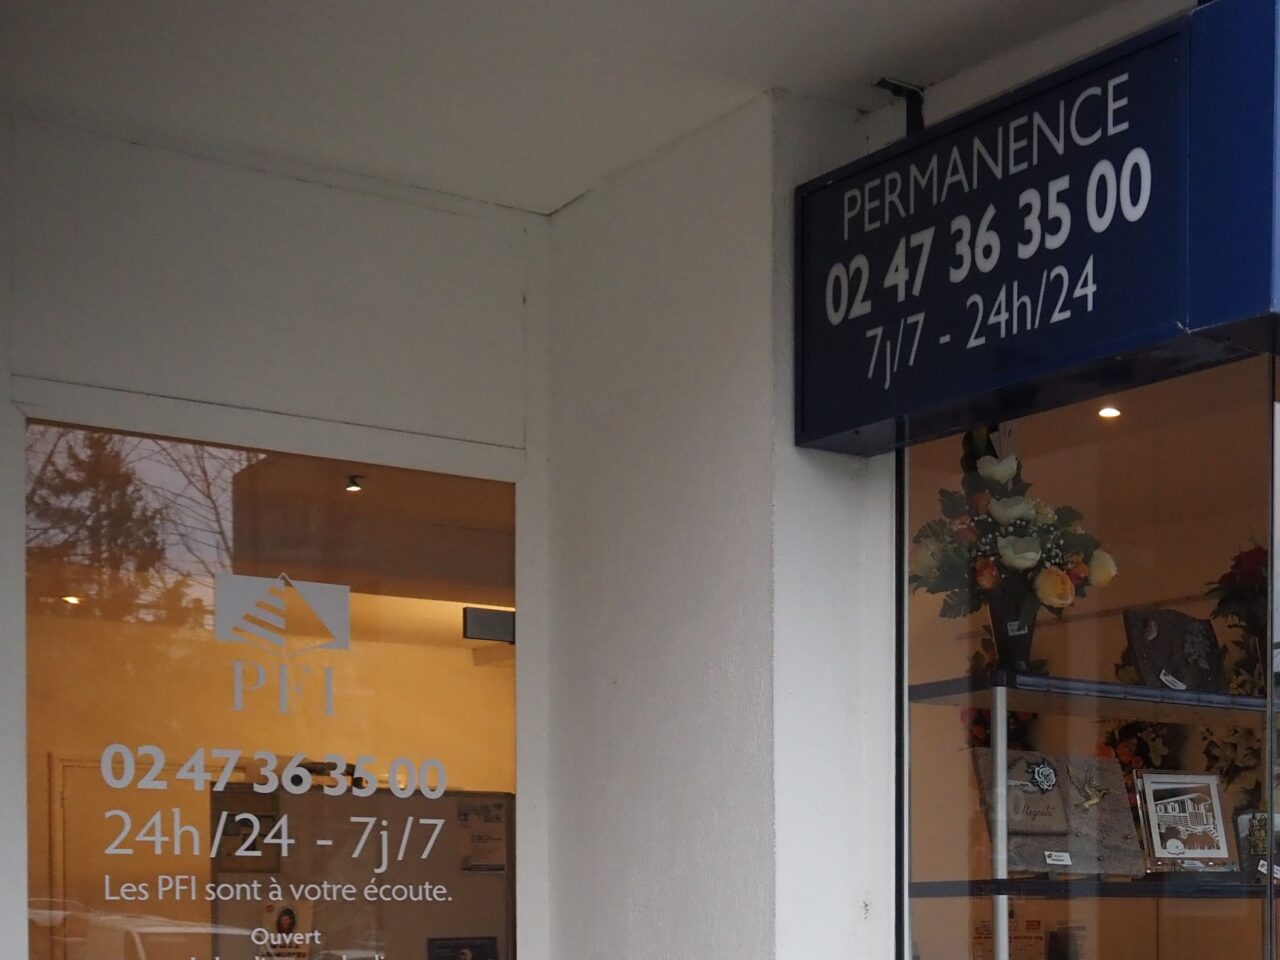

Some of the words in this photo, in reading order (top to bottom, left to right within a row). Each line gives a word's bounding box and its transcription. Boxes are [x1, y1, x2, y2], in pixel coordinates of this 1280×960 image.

[843, 72, 1130, 241] PERMANENCE
[825, 254, 871, 326] 02
[884, 226, 936, 303] 47
[949, 204, 1001, 283] 36
[1017, 174, 1071, 260] 35
[1086, 147, 1152, 233] 00
[865, 312, 926, 390] 7j/7
[966, 254, 1097, 349] 24h/24
[229, 659, 336, 717] PFI
[101, 744, 168, 790] 02
[175, 747, 242, 792] 47
[253, 750, 313, 795] 36
[323, 753, 377, 798] 35
[389, 757, 447, 800] 00
[104, 808, 295, 859] 24h/24
[350, 816, 446, 874] 7j/7
[104, 874, 149, 901] Les
[158, 876, 197, 900] PFI
[205, 878, 262, 901] sont
[269, 876, 282, 901] à
[292, 879, 357, 901] votre
[364, 877, 452, 902] écoute.
[251, 928, 321, 945] Ouvert
